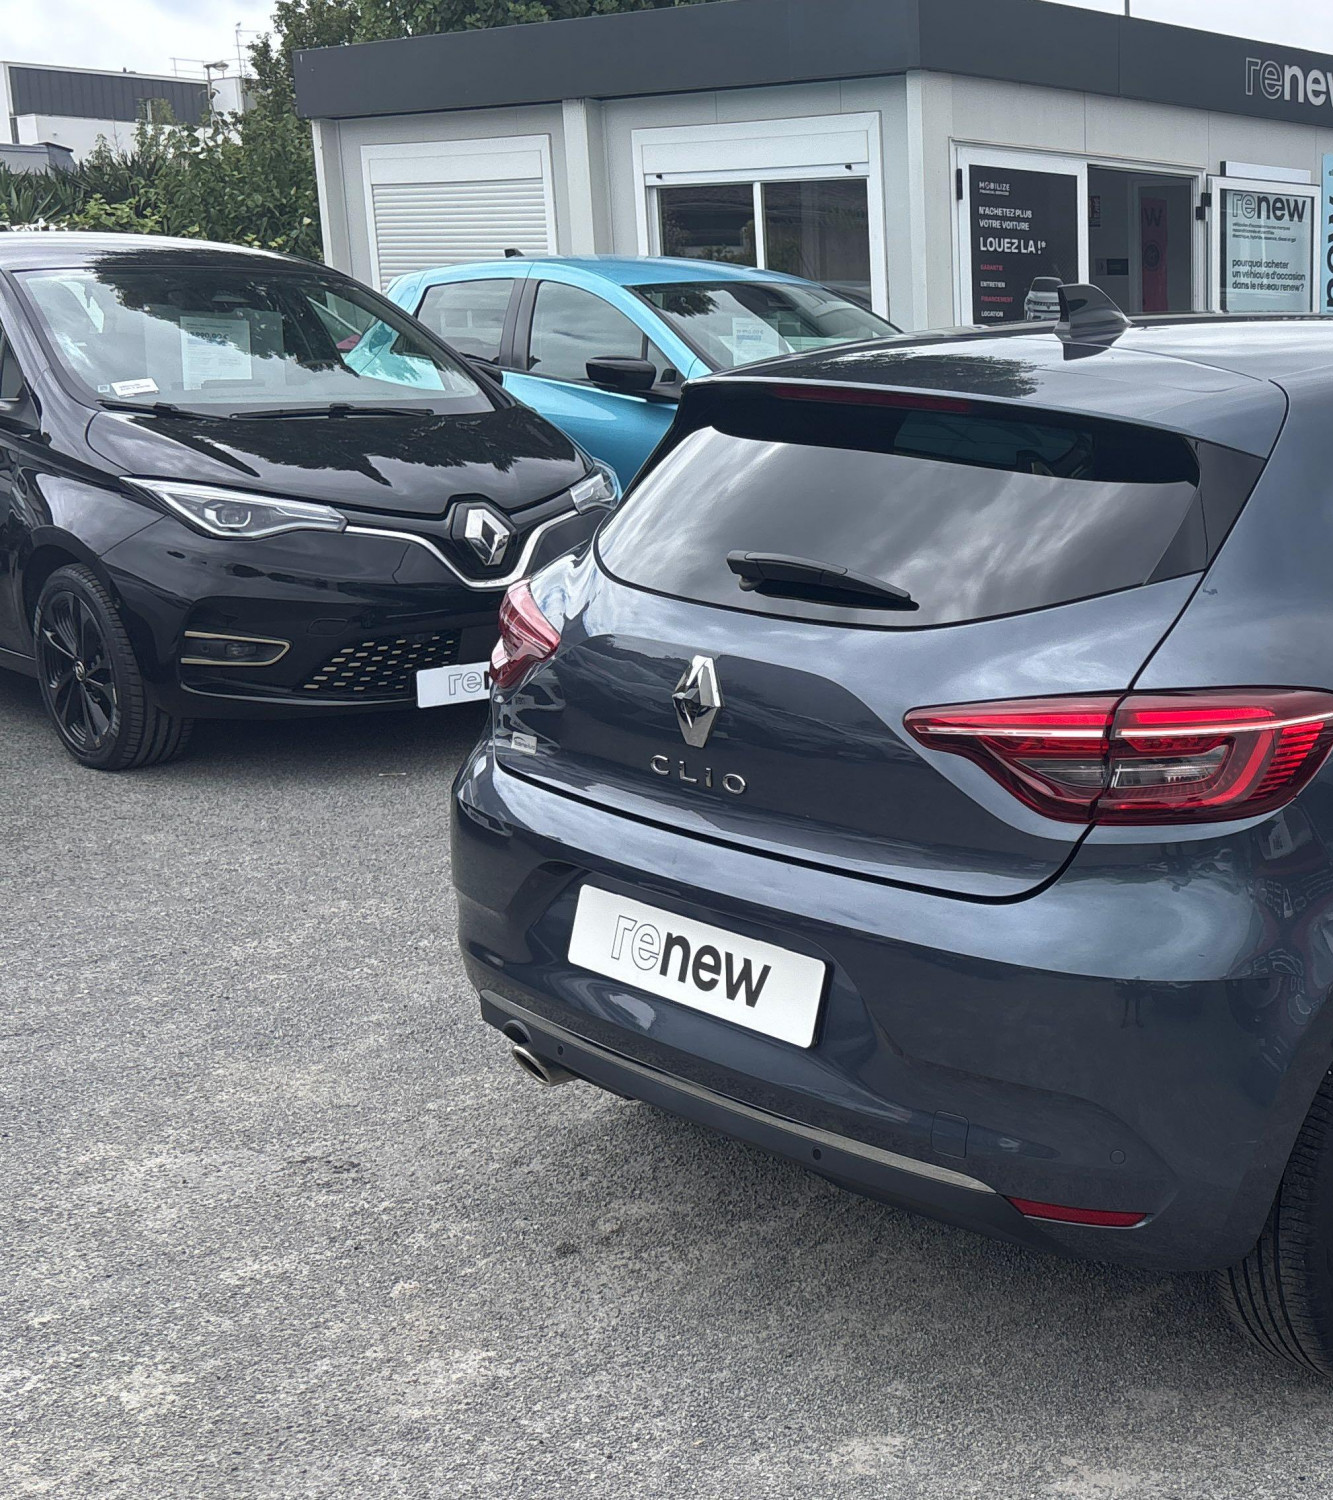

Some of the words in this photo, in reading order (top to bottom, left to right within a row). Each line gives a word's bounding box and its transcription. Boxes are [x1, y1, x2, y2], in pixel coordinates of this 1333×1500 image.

[978, 181, 1010, 191] MOBILIZE
[978, 206, 1015, 218] N'ACHETEZ
[1015, 208, 1033, 219] PLUS
[1232, 192, 1307, 223] renew
[978, 218, 1001, 229] VOTRE
[1001, 221, 1030, 231] VOITURE
[979, 237, 1019, 253] LOUEZ
[1020, 239, 1036, 254] LA
[1232, 259, 1263, 269] pourquoi
[1263, 259, 1289, 269] acheter
[1232, 270, 1241, 279] un
[1241, 269, 1270, 280] véhicule
[1270, 270, 1306, 281] d'occasion
[1232, 280, 1250, 290] dans
[1250, 281, 1257, 290] le
[1257, 281, 1280, 291] réseau
[981, 310, 1004, 318] LOCATION
[650, 754, 747, 795] CLIO
[611, 914, 772, 1008] renew
